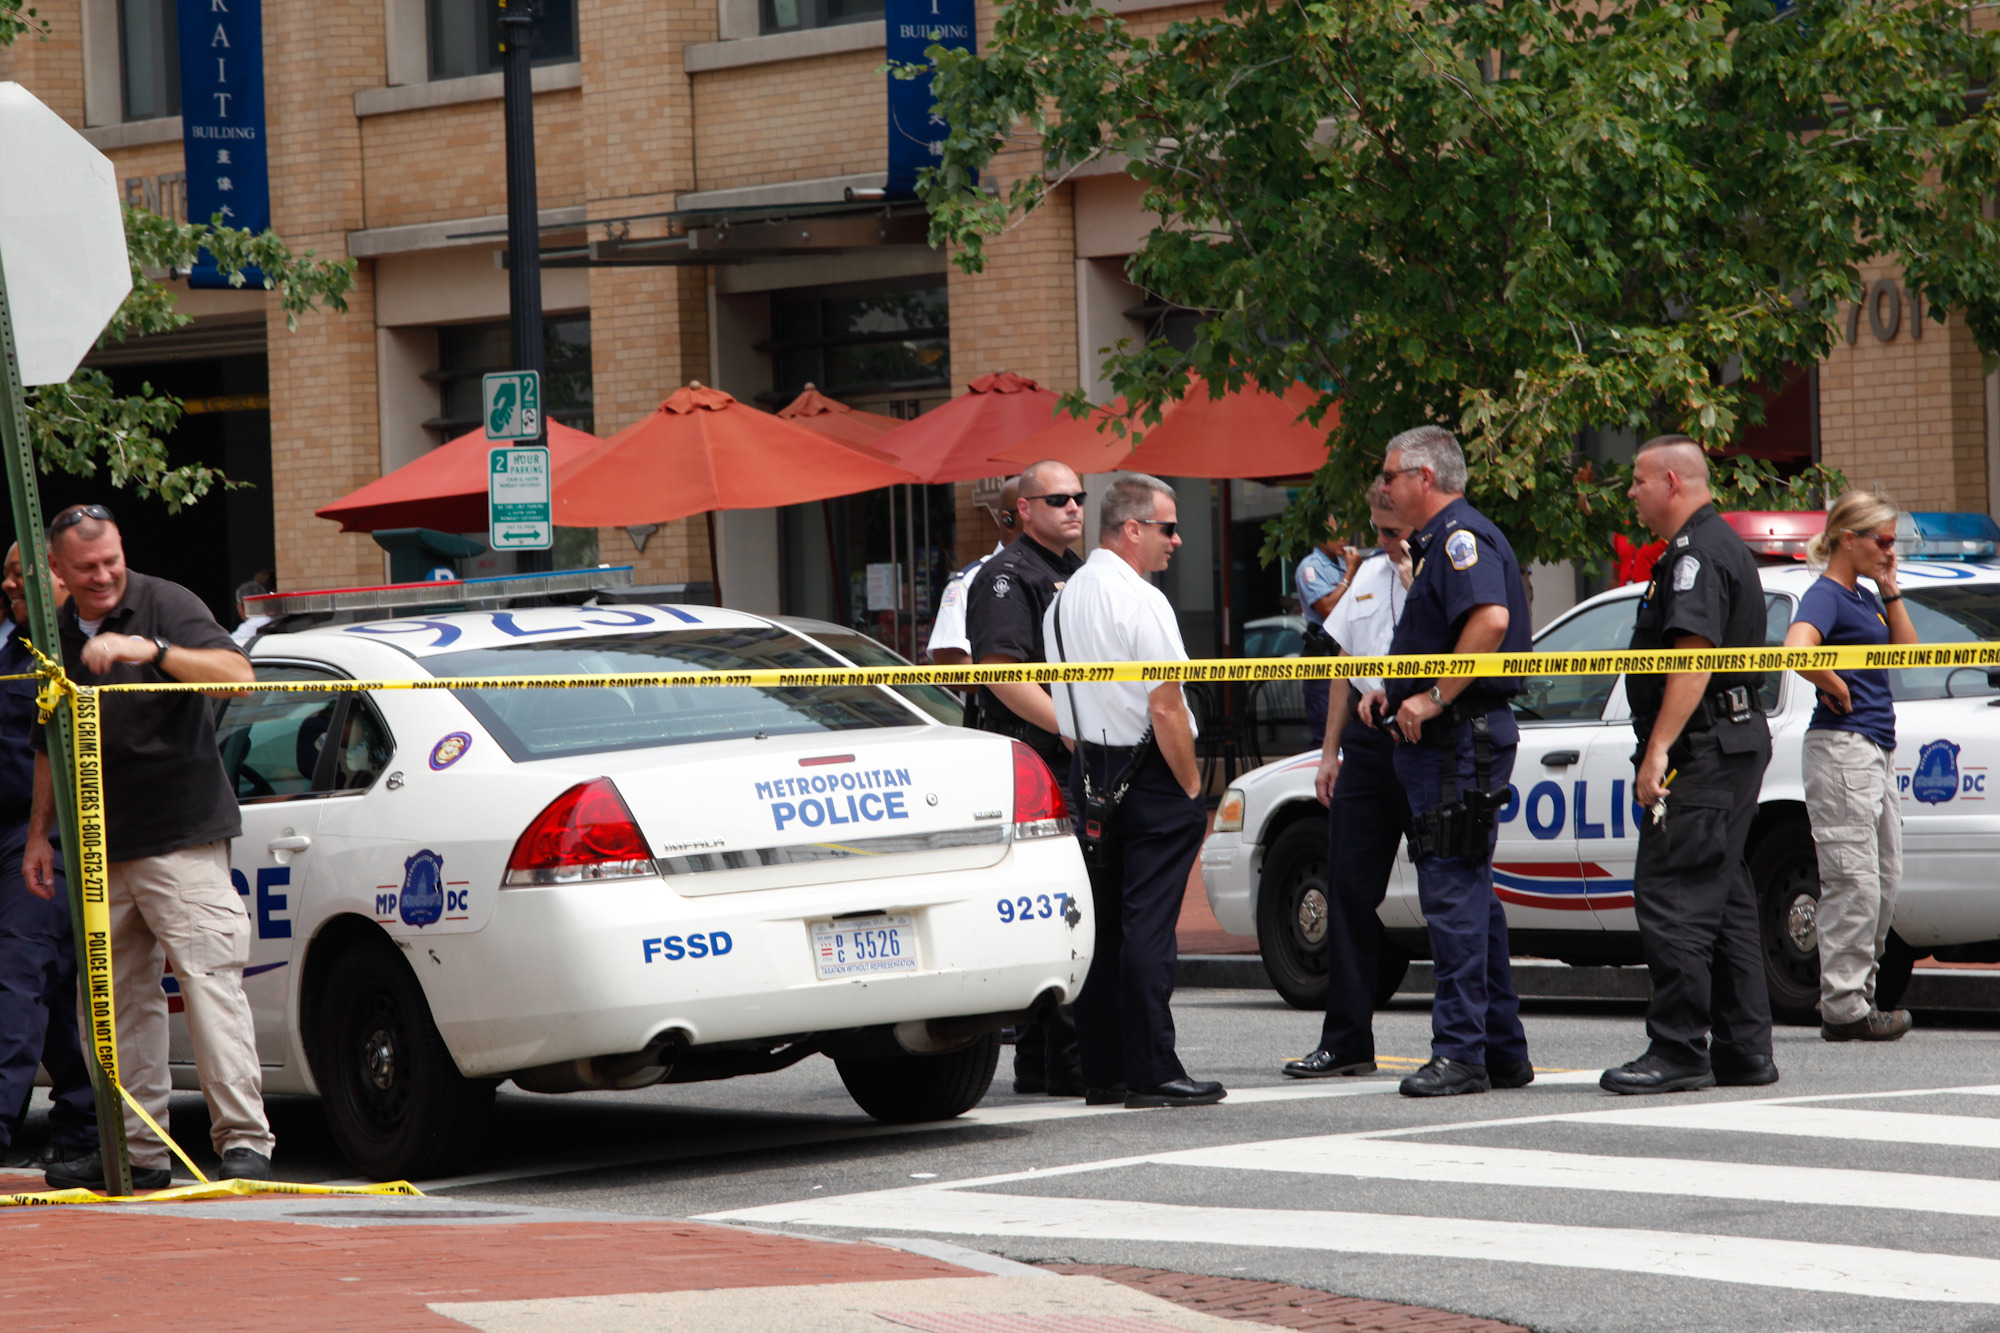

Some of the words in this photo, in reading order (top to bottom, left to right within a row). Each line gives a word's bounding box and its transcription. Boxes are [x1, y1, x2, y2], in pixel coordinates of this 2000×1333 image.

[899, 24, 968, 39] BUILDING
[192, 125, 255, 139] BUILDING
[524, 376, 535, 402] 2
[496, 455, 505, 471] 2
[513, 454, 540, 465] HOUR
[510, 465, 543, 474] PARKING
[1503, 658, 1542, 673] POLICE
[1545, 658, 1568, 673] LINE
[1571, 657, 1586, 672] DO
[1589, 657, 1613, 672] NOT
[1615, 656, 1654, 671] CROSS
[1656, 655, 1694, 671] CRIME
[1696, 654, 1746, 670] SOLVERS
[1749, 652, 1839, 668] 1-800-673-2777
[1865, 650, 1905, 666] POLICE
[1908, 650, 1932, 665] LINE
[1934, 649, 1950, 664] DO
[1953, 648, 1977, 664] NOT
[779, 674, 819, 687] POLICE
[822, 673, 848, 686] LINE
[849, 673, 865, 685] DO
[867, 672, 891, 685] NOT
[892, 671, 931, 684] CROSS
[934, 671, 972, 684] CRIME
[973, 669, 1023, 683] SOLVERS
[1025, 668, 1115, 682] 1-800-673-2777
[1142, 666, 1181, 680] POLICE
[1184, 665, 1209, 679] LINE
[1210, 665, 1226, 679] DO
[1228, 664, 1251, 678] NOT
[1254, 663, 1292, 678] CROSS
[1295, 663, 1332, 677] CRIME
[1334, 661, 1384, 676] SOLVERS
[1386, 659, 1476, 675] 1-800-673-2777
[78, 722, 97, 759] CRIME
[80, 761, 100, 811] SOLVERS
[754, 768, 912, 800] METROPOLITAN
[1962, 774, 1986, 792] DC
[771, 791, 910, 831] POLICE
[82, 813, 104, 903] 1-800-673-2777
[376, 893, 398, 915] MP
[447, 890, 468, 911] DC
[997, 892, 1069, 923] 9237
[88, 931, 107, 972] POLICE
[643, 931, 733, 963] FSSD
[853, 929, 900, 960] 5526
[821, 965, 846, 975] TAXATION
[846, 962, 870, 972] WITHOUT
[870, 959, 915, 970] REPRESENTATION
[91, 973, 109, 999] LINE
[93, 1001, 110, 1017] DO
[95, 1019, 112, 1043] NOT
